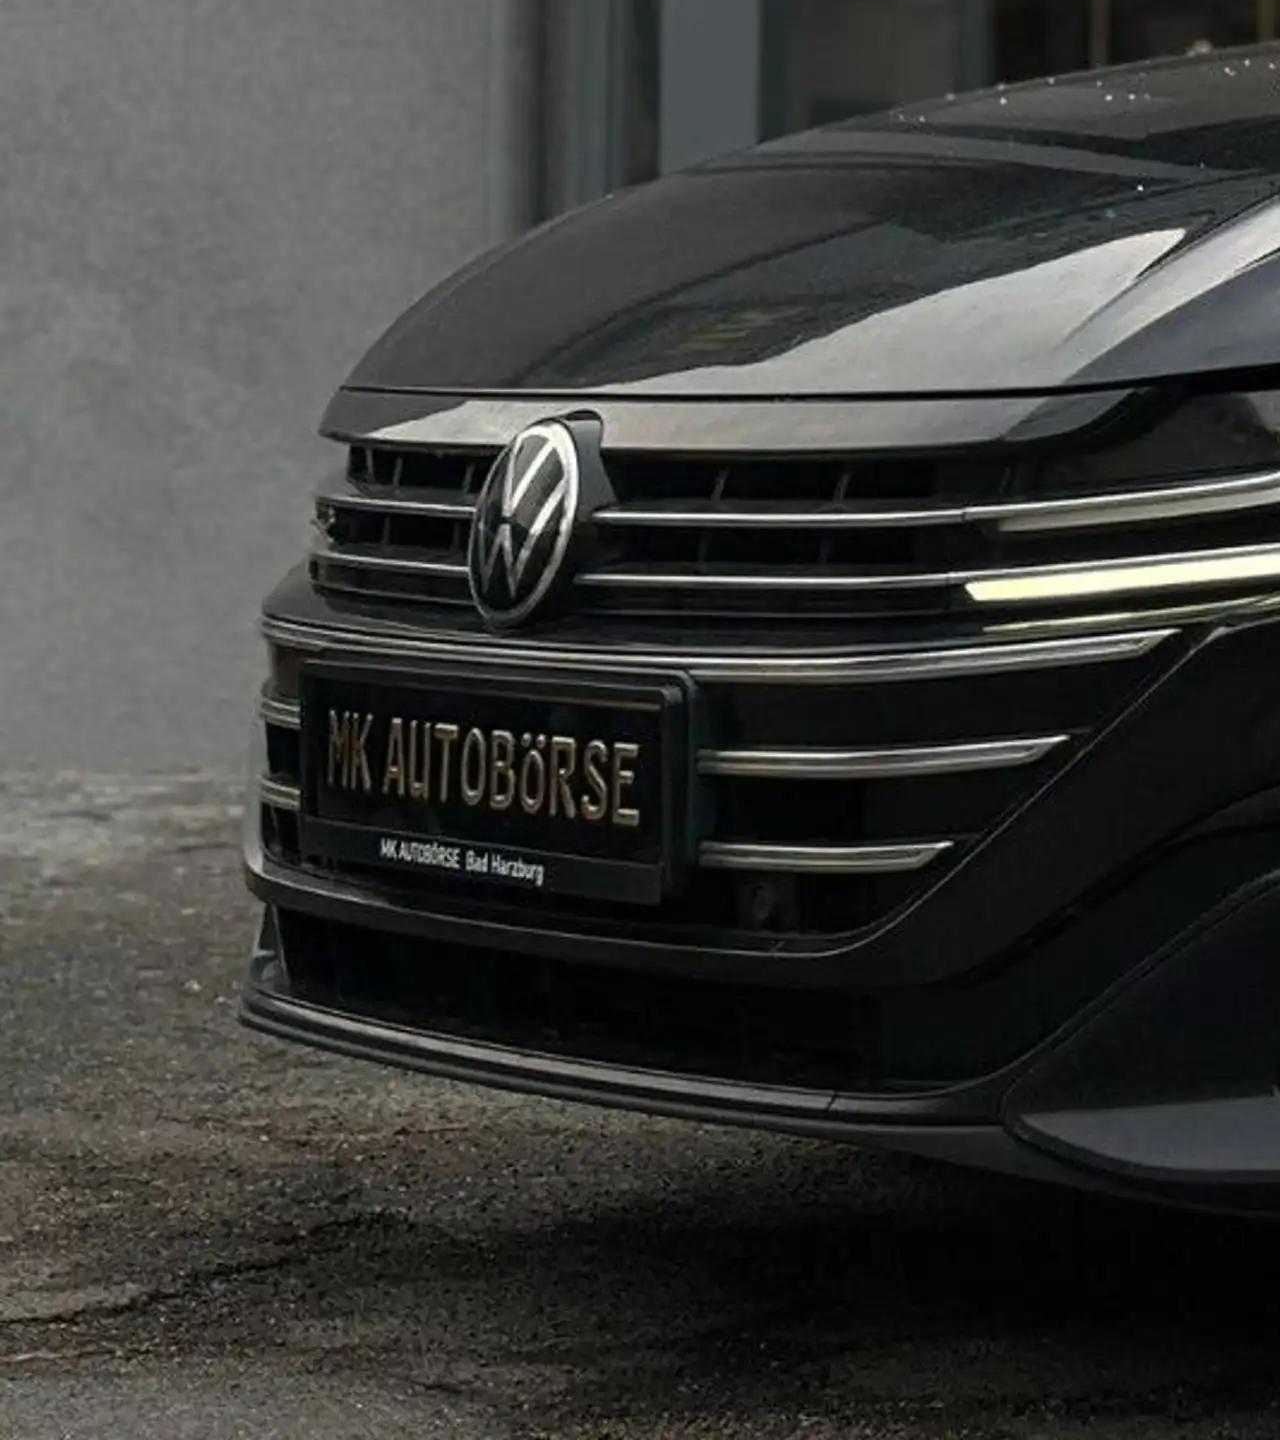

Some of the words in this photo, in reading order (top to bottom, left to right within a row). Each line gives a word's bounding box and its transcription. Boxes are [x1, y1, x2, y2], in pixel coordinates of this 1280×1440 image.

[327, 708, 374, 793] MK
[382, 717, 642, 827] AUTOBÖRSE
[380, 837, 397, 860] MK
[399, 841, 461, 870] AUTOBÖRSE
[465, 849, 488, 873] Bad
[492, 853, 544, 887] Harzburg
